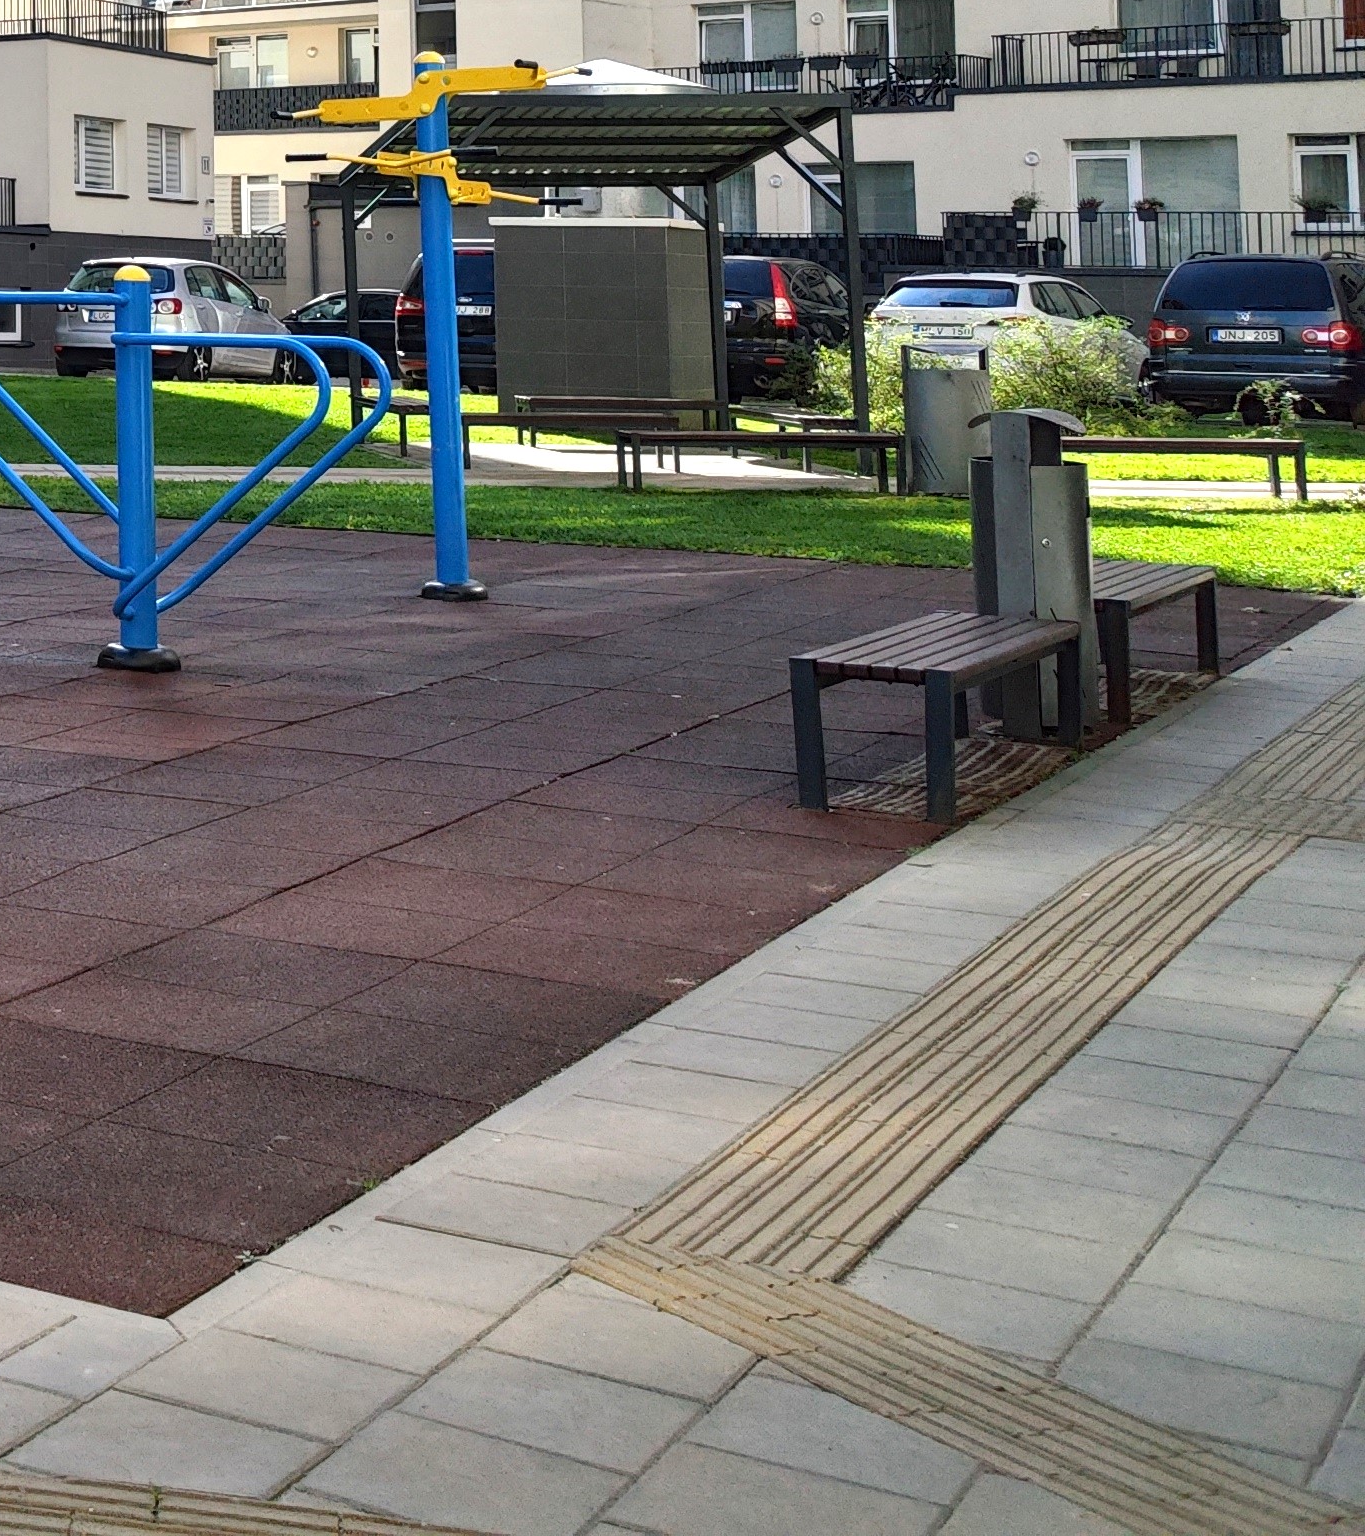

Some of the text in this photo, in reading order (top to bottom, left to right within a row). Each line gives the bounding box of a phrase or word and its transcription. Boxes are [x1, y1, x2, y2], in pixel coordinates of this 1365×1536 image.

[93, 312, 110, 320] LUG
[1220, 331, 1276, 340] JNJ 205
